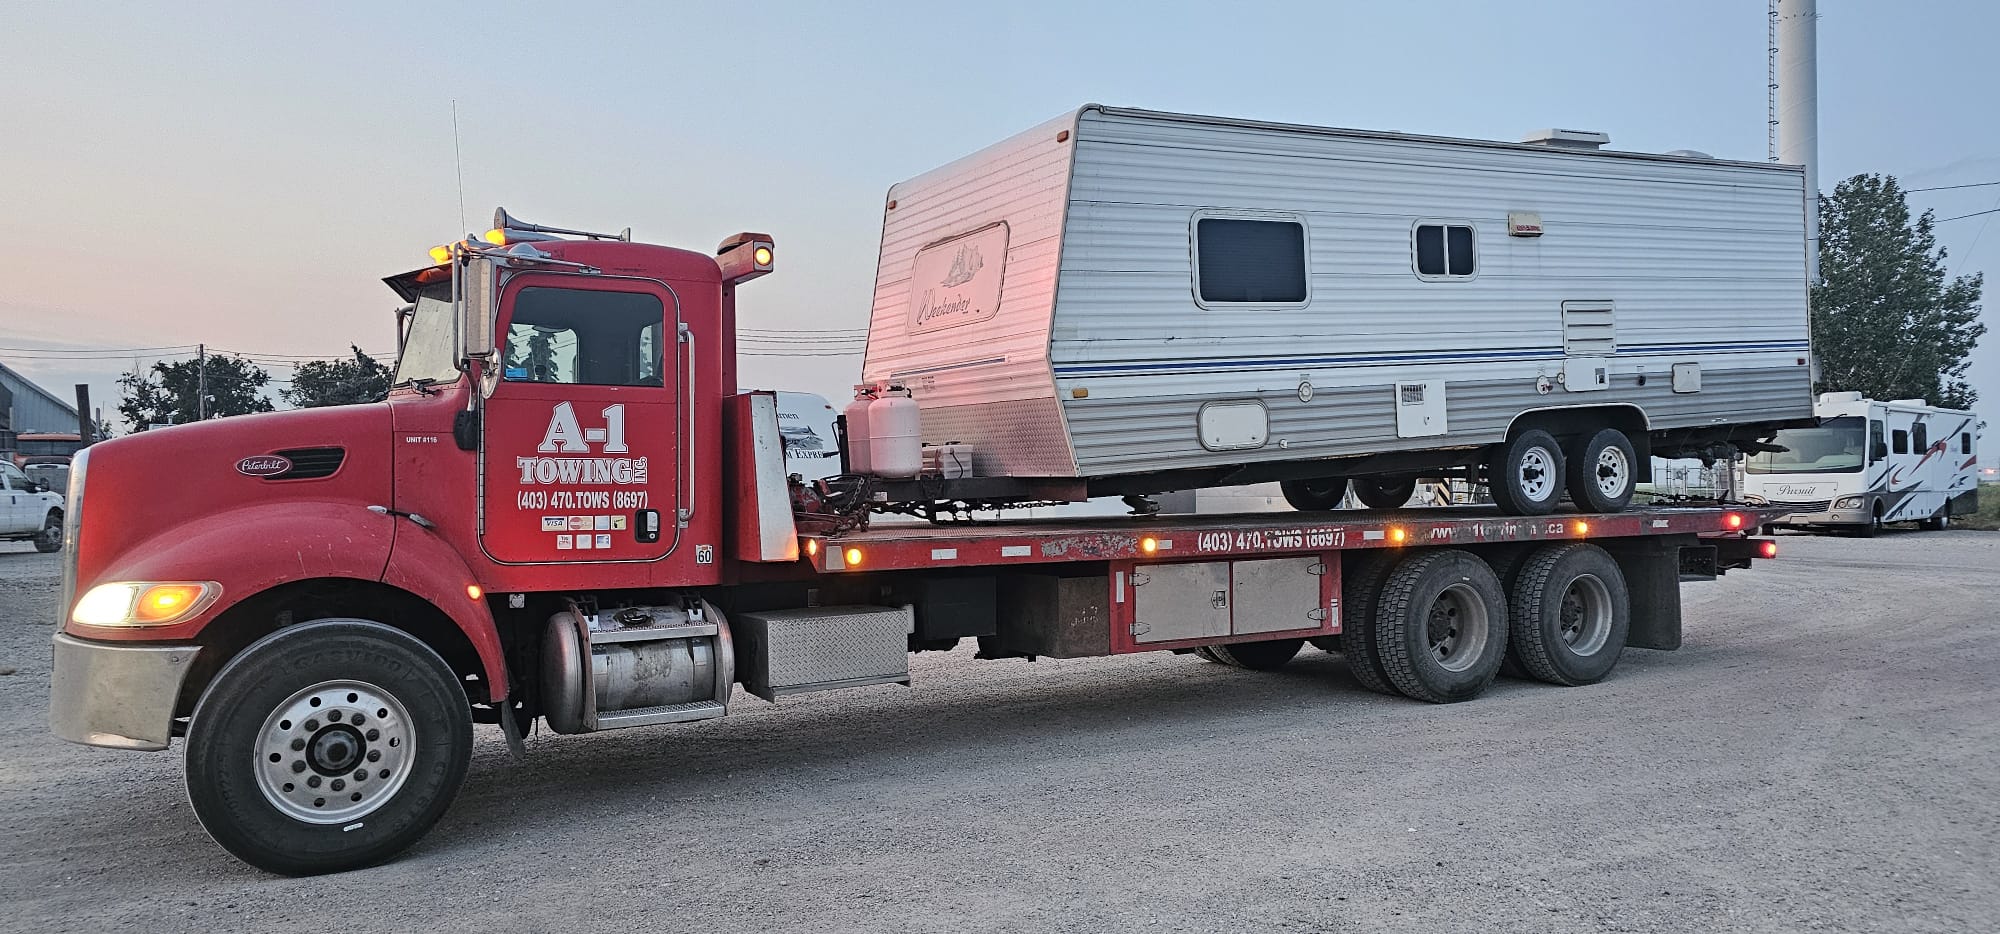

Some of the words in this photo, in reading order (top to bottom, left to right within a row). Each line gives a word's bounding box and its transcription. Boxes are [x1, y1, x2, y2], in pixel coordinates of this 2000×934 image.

[538, 401, 628, 453] A-1
[242, 459, 284, 471] Peterbilt
[517, 456, 632, 484] TOWING
[517, 491, 547, 510] (403)
[550, 491, 609, 509] 470.TOWS
[613, 490, 648, 509] (8697)
[1776, 485, 1816, 496] Pursuit
[1198, 532, 1233, 552] (403)
[1306, 528, 1345, 548] (8697)
[698, 550, 711, 562] 60
